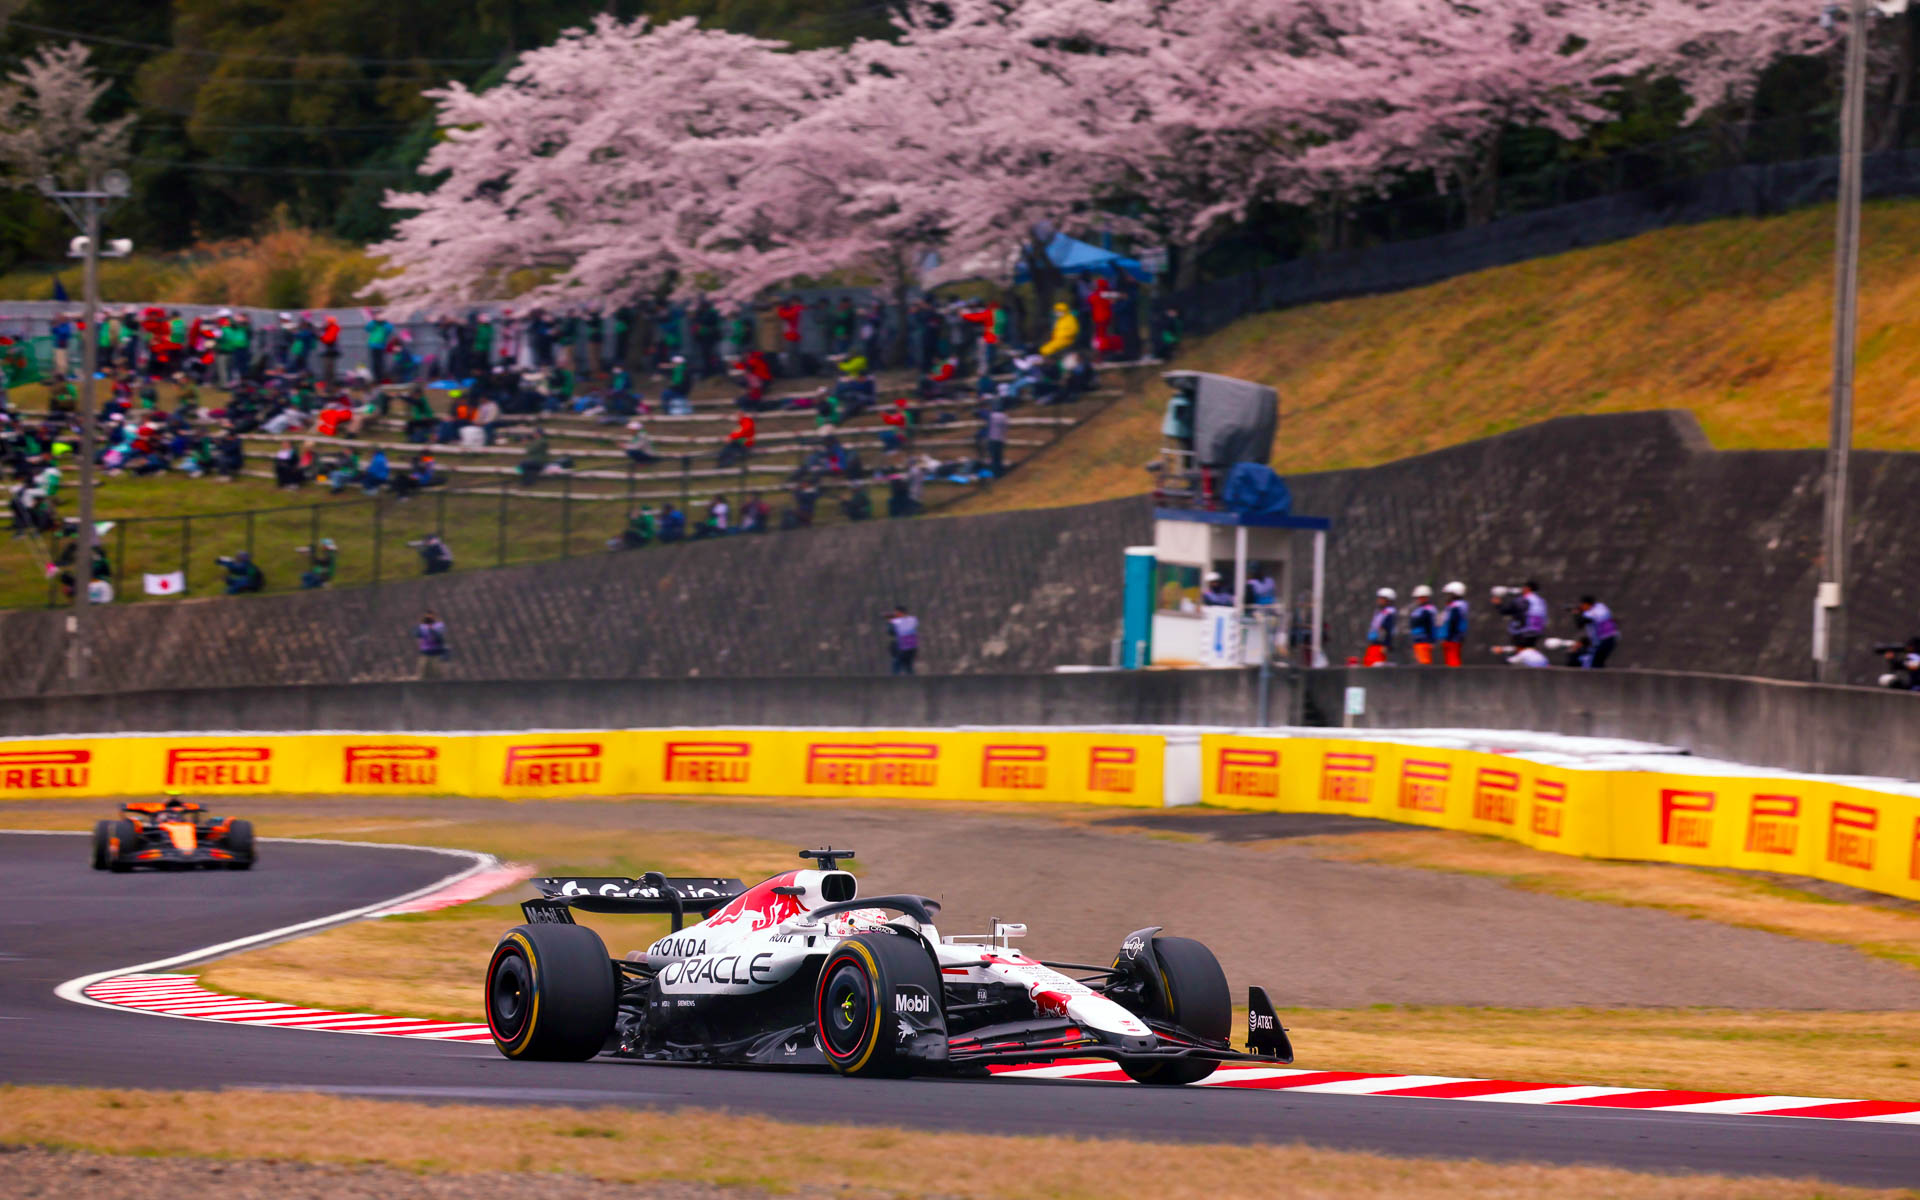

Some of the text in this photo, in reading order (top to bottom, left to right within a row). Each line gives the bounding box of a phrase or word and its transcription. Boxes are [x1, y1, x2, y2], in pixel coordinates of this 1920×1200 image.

[163, 747, 273, 786] PIRELLI
[342, 744, 438, 785] PIRELLI
[502, 742, 603, 787] PIRELLI
[662, 741, 752, 783] PIRELLI
[980, 744, 1047, 790] PIRELLI
[1216, 747, 1280, 798] PIRELLI
[1319, 751, 1376, 803] PIRELLI
[1397, 758, 1451, 813] PIRELLI
[1658, 788, 1716, 849] PIRELLI
[1744, 794, 1800, 857] PIRELLI
[1825, 800, 1880, 871] PIRELLI
[525, 906, 558, 924] Mobil
[651, 938, 706, 957] HONDA
[665, 952, 780, 986] ORACLE
[896, 994, 930, 1013] Mobil
[1257, 1015, 1273, 1030] AT&T
